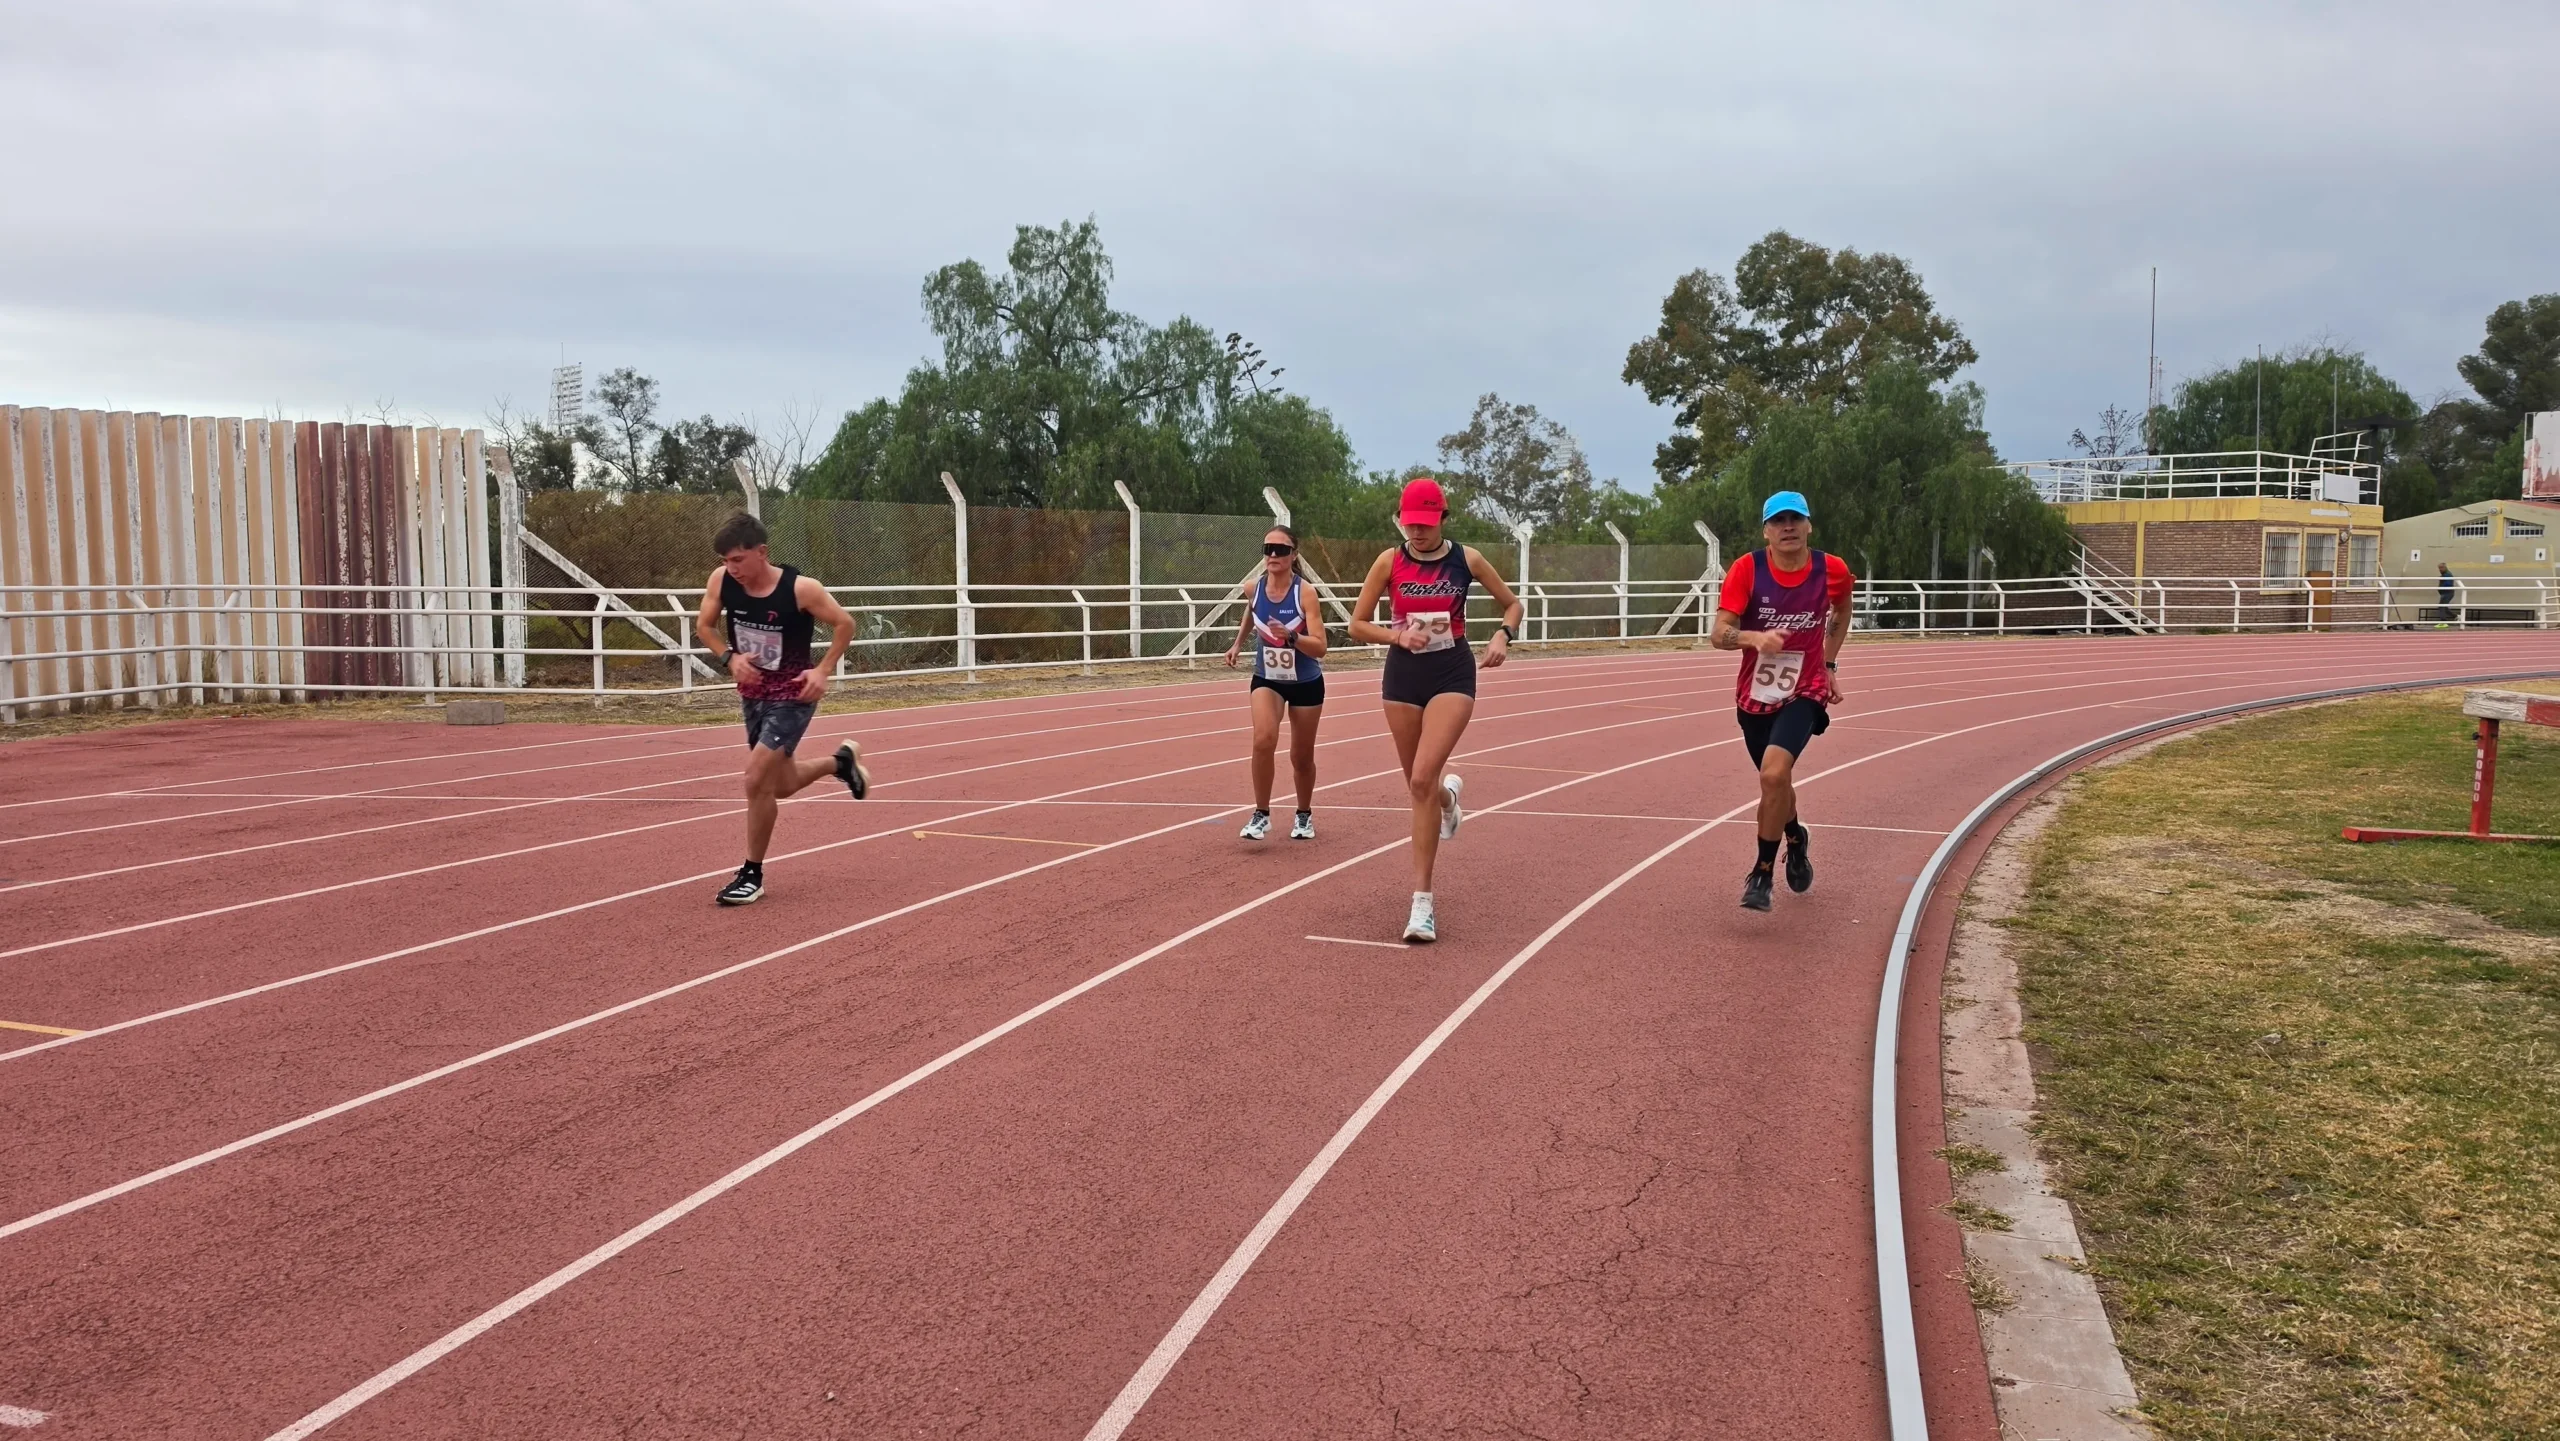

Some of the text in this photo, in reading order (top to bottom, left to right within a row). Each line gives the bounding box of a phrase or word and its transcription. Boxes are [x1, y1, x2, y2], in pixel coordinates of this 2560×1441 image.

[1757, 613, 1808, 622] PURA
[739, 636, 778, 661] 376
[1264, 649, 1294, 670] 39
[1755, 663, 1799, 692] 55
[2473, 748, 2484, 802] MONDO
